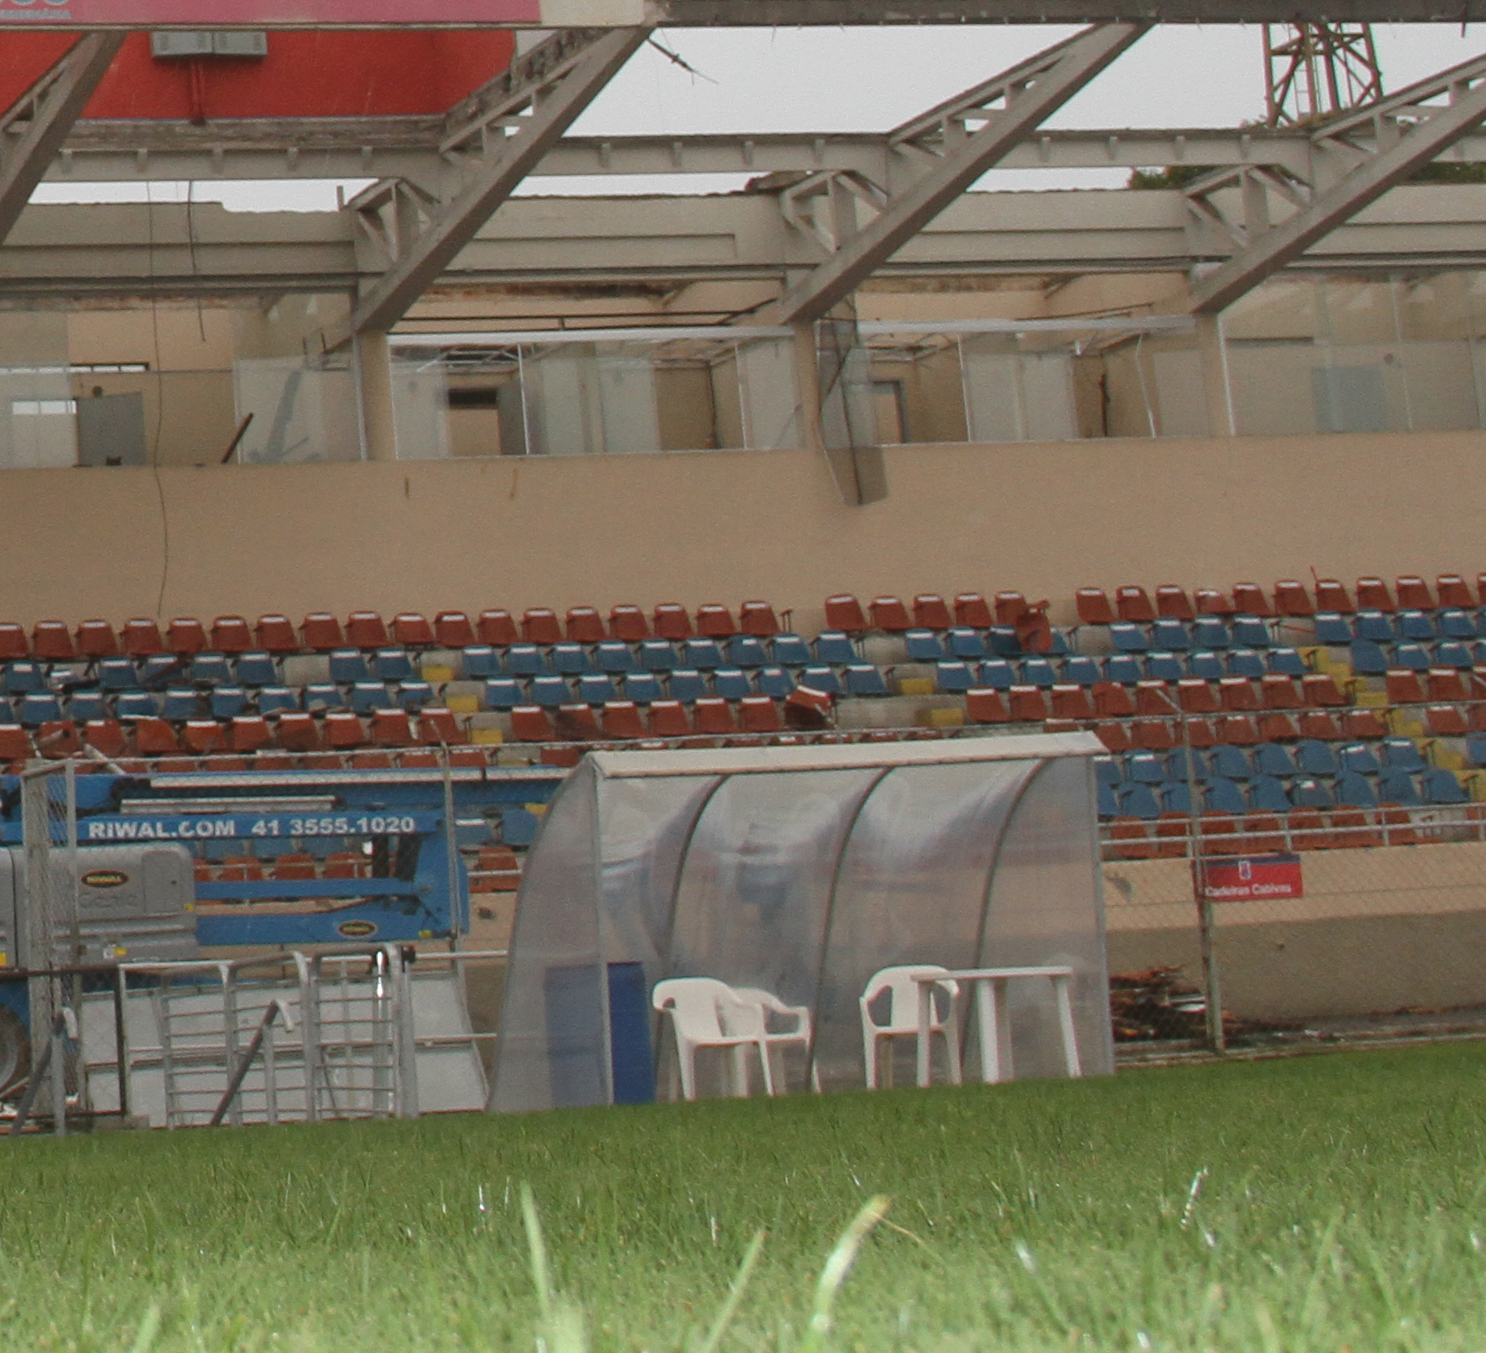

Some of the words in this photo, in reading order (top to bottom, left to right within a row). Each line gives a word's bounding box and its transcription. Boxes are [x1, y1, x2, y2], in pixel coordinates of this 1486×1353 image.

[87, 820, 235, 839] RIWAL.COM
[251, 820, 280, 837] 41
[290, 816, 416, 835] 3555.1020
